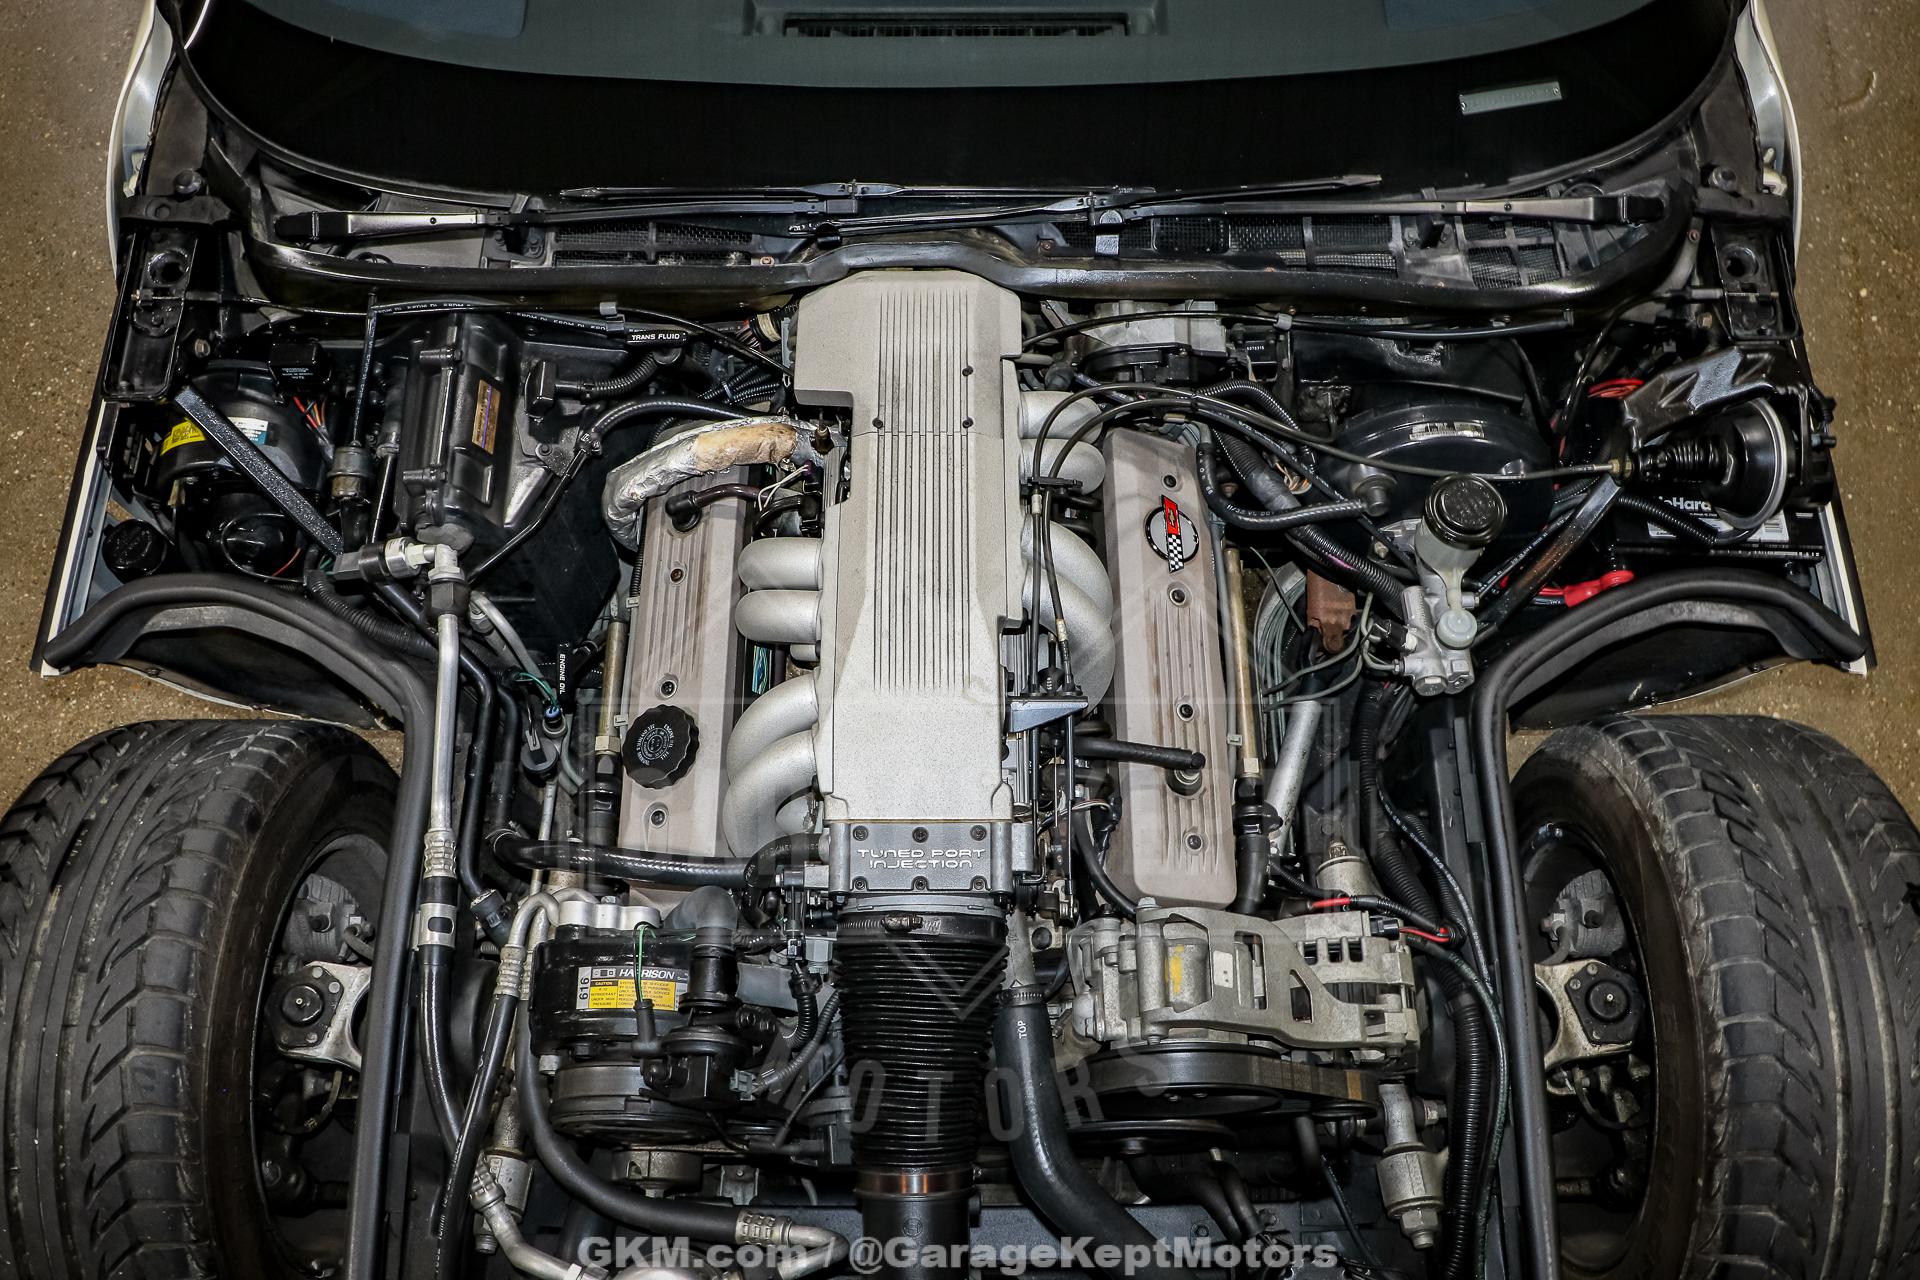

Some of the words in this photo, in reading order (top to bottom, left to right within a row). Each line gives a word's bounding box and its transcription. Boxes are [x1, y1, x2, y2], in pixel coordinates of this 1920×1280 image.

[631, 333, 655, 341] TRANS
[857, 849, 925, 858] TUNED
[931, 848, 986, 858] PORT
[619, 968, 675, 980] HARISON
[578, 977, 590, 1000] 616
[1017, 1020, 1028, 1039] TOP
